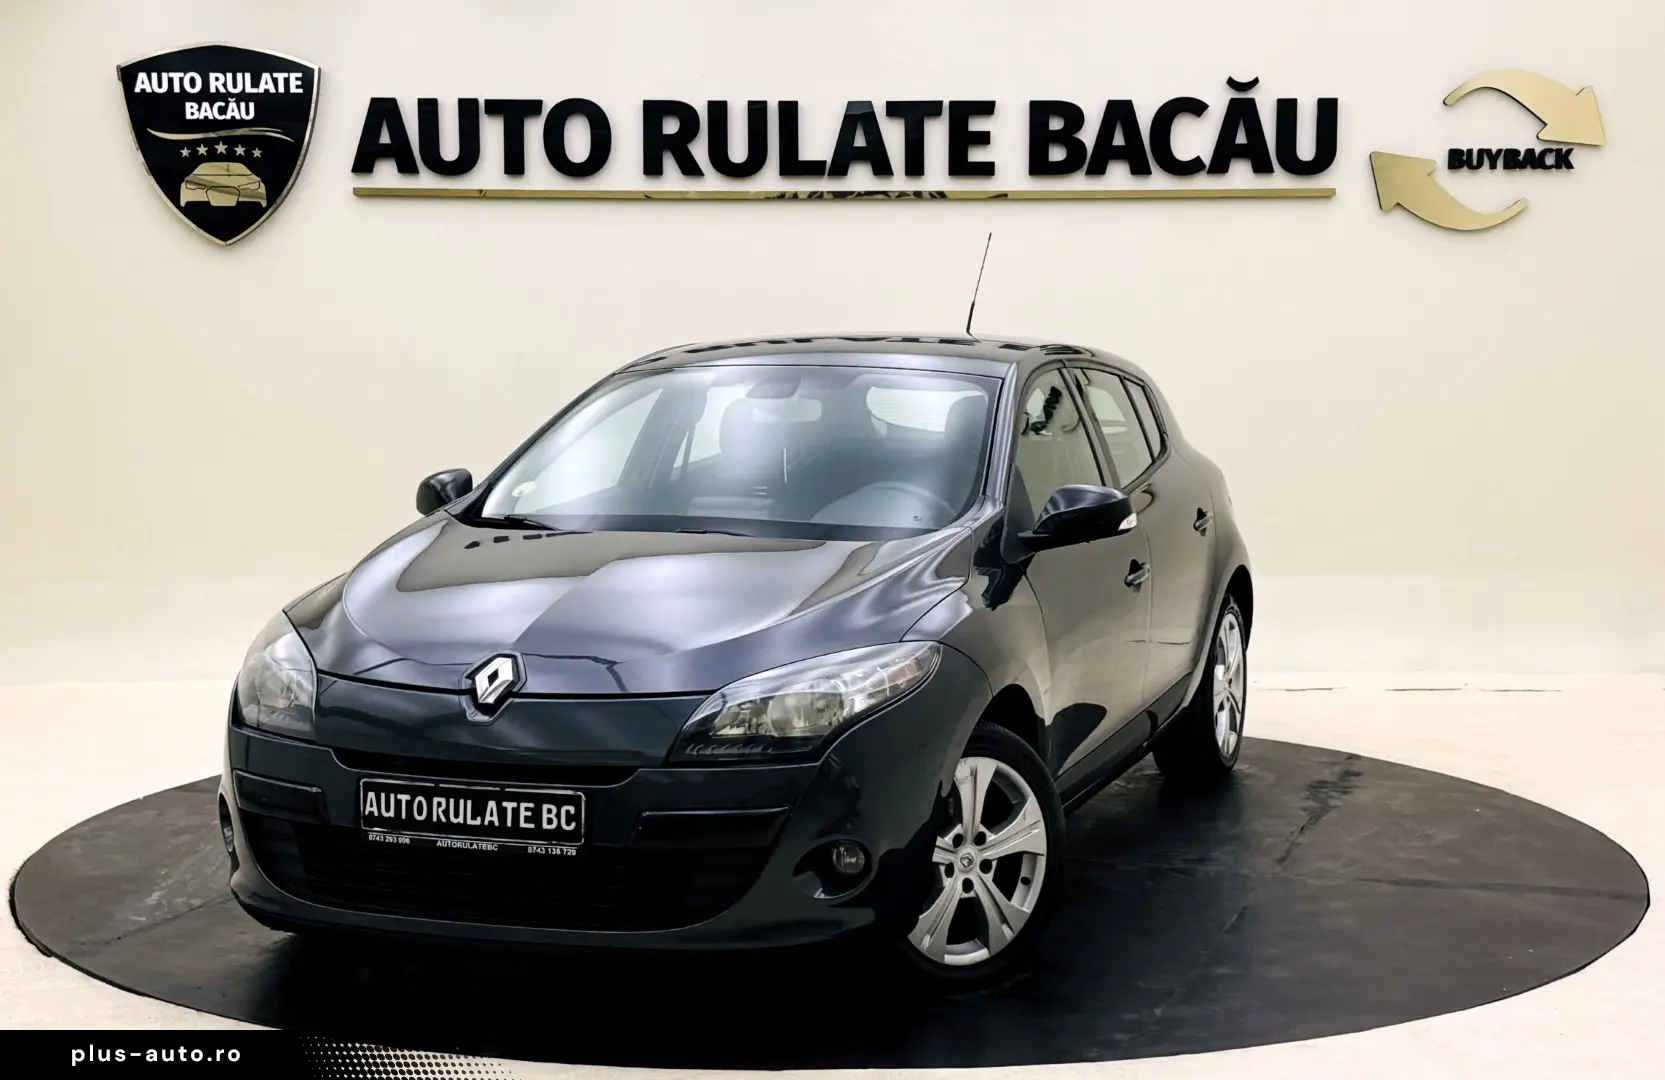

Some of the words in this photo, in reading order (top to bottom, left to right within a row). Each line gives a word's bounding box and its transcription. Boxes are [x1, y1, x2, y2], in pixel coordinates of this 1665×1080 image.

[134, 72, 203, 94] AUTO
[209, 72, 304, 94] RULATE
[185, 97, 256, 121] BACĂU
[351, 97, 612, 178] AUTO
[643, 100, 996, 178] RULATE
[1028, 76, 1339, 177] BACĂU
[1447, 147, 1575, 171] BUYBACK
[364, 791, 428, 821] AUTO
[432, 796, 536, 829] RULATE
[541, 803, 577, 831] BC
